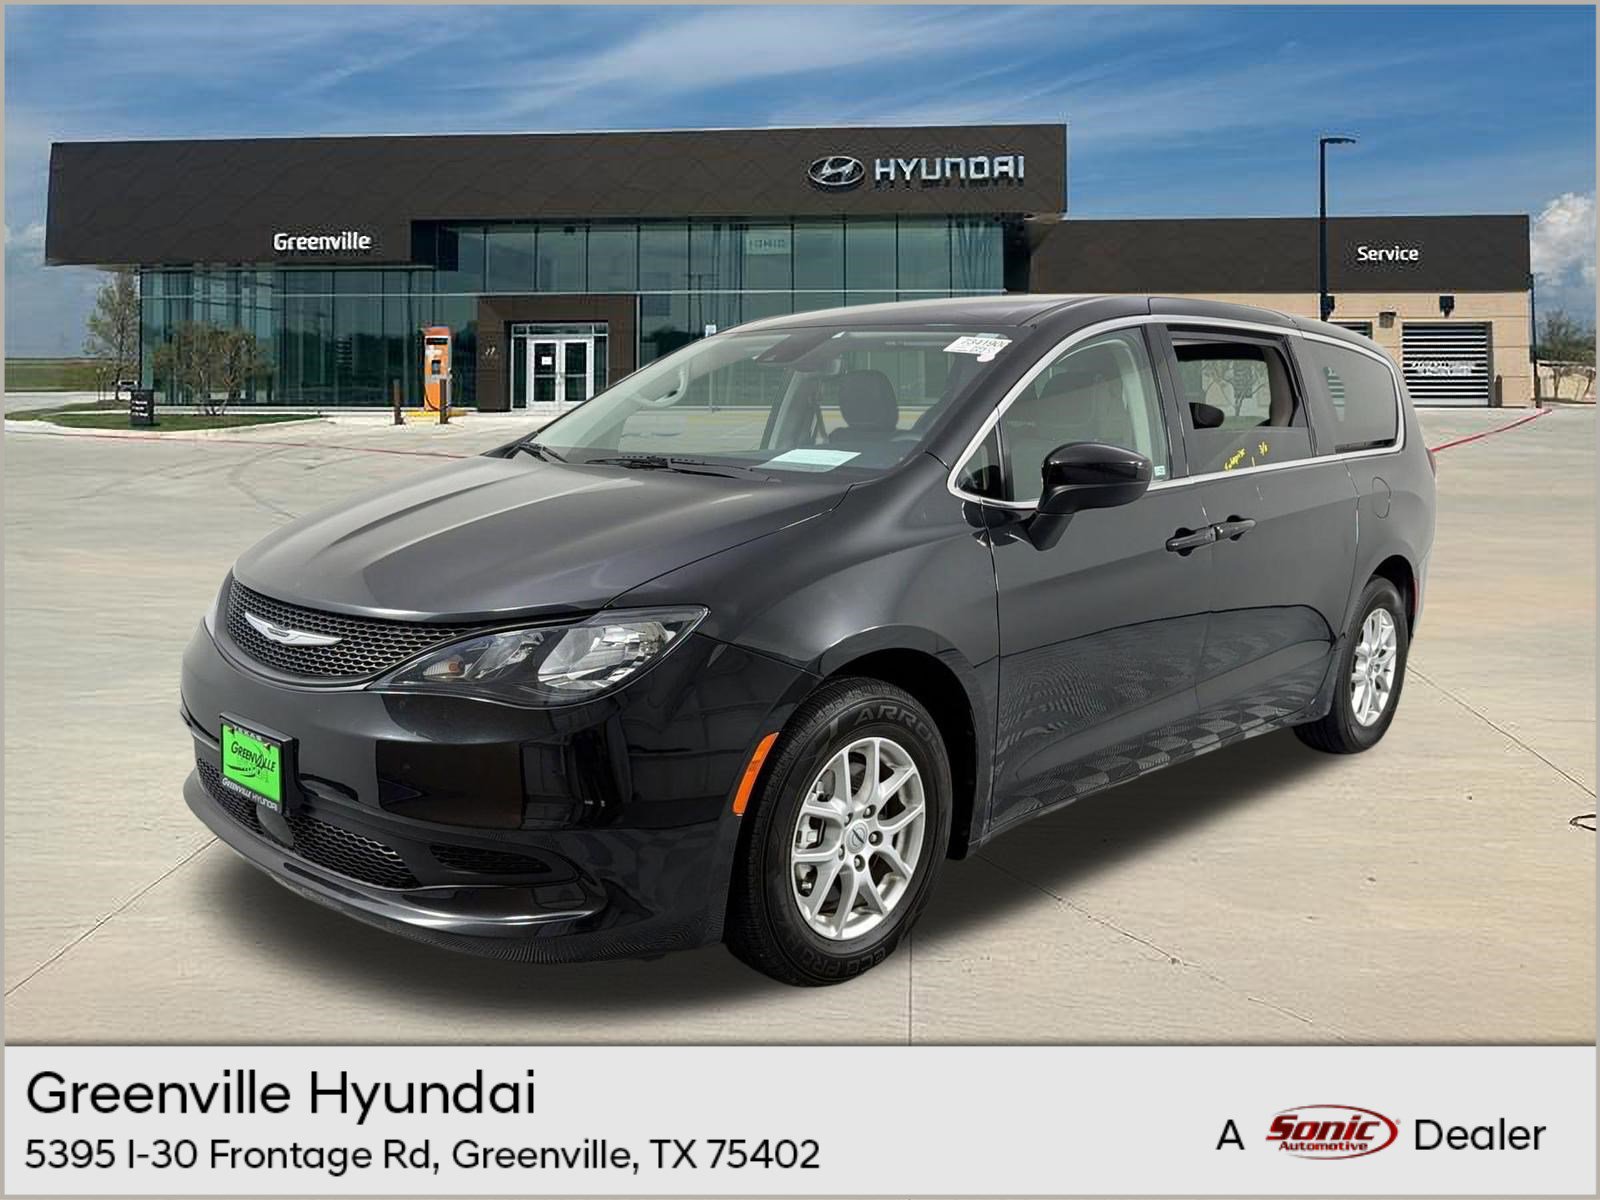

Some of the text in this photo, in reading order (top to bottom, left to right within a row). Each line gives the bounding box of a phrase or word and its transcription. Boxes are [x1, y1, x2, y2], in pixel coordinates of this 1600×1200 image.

[874, 155, 1025, 182] HYUNDAI
[273, 231, 372, 251] Greenville
[1356, 244, 1420, 263] Service
